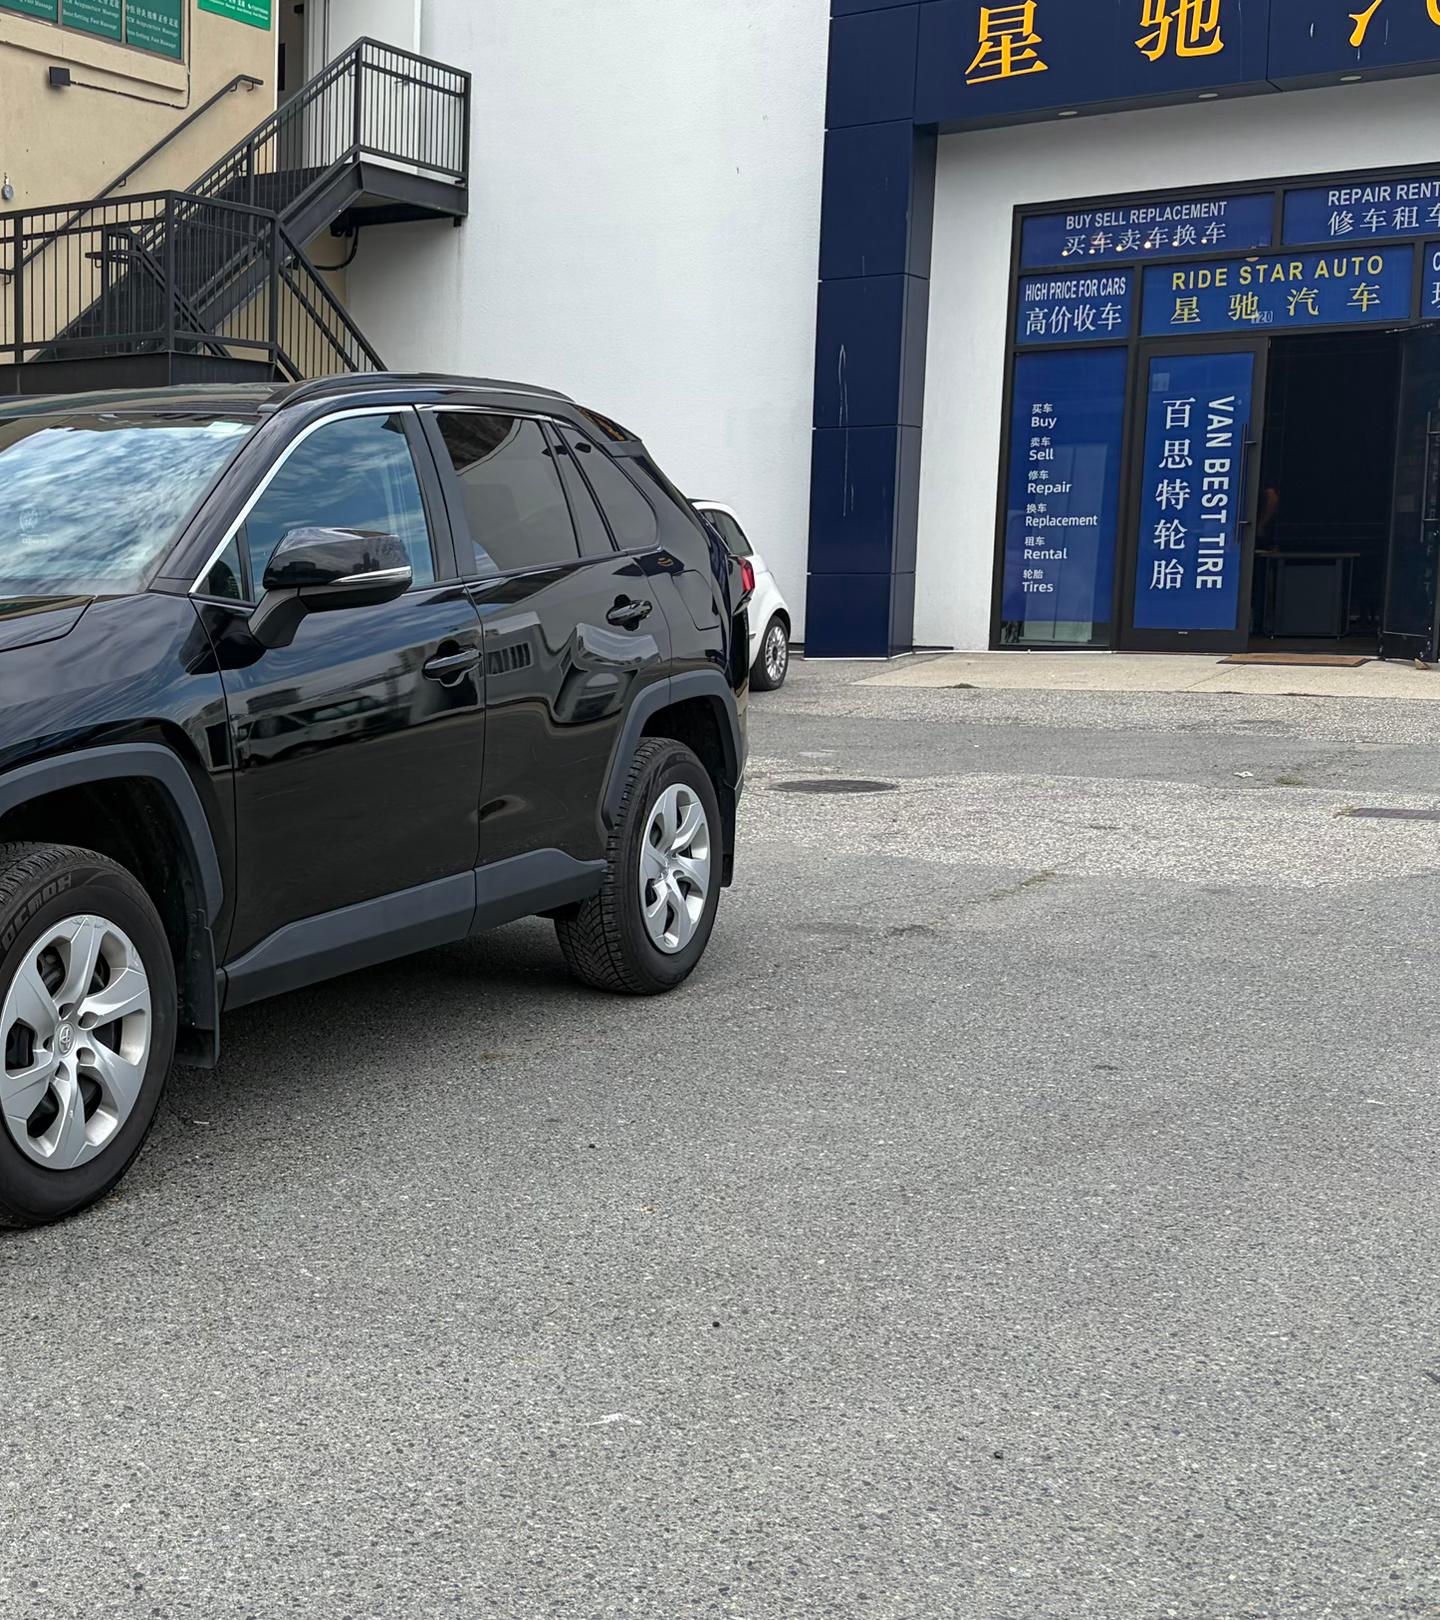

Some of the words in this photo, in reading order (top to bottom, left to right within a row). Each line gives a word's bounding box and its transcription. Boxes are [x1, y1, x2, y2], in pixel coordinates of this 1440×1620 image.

[1328, 186, 1391, 206] REPAIR
[1066, 214, 1092, 230] BUY
[1094, 211, 1126, 227] SELL
[1130, 201, 1227, 224] REPLACEMENT
[1172, 267, 1228, 291] RIDE
[1239, 261, 1304, 285] STAR
[1314, 255, 1383, 279] AUTO
[1025, 283, 1048, 301] HIGH
[1049, 280, 1077, 300] PRICE
[1079, 279, 1098, 298] FOR
[1100, 277, 1126, 296] CARS
[1025, 302, 1122, 336] 高价收车
[1031, 416, 1057, 429] Buy
[1205, 395, 1235, 448] VAN
[1029, 448, 1054, 461] Sell
[1027, 481, 1072, 495] Repair
[1150, 397, 1196, 591] 百思特轮胎
[1200, 458, 1231, 523] BEST
[1025, 515, 1098, 528] Replacement
[1024, 547, 1068, 560] Rental
[1196, 533, 1226, 589] TIRE
[1022, 580, 1054, 593] Tires
